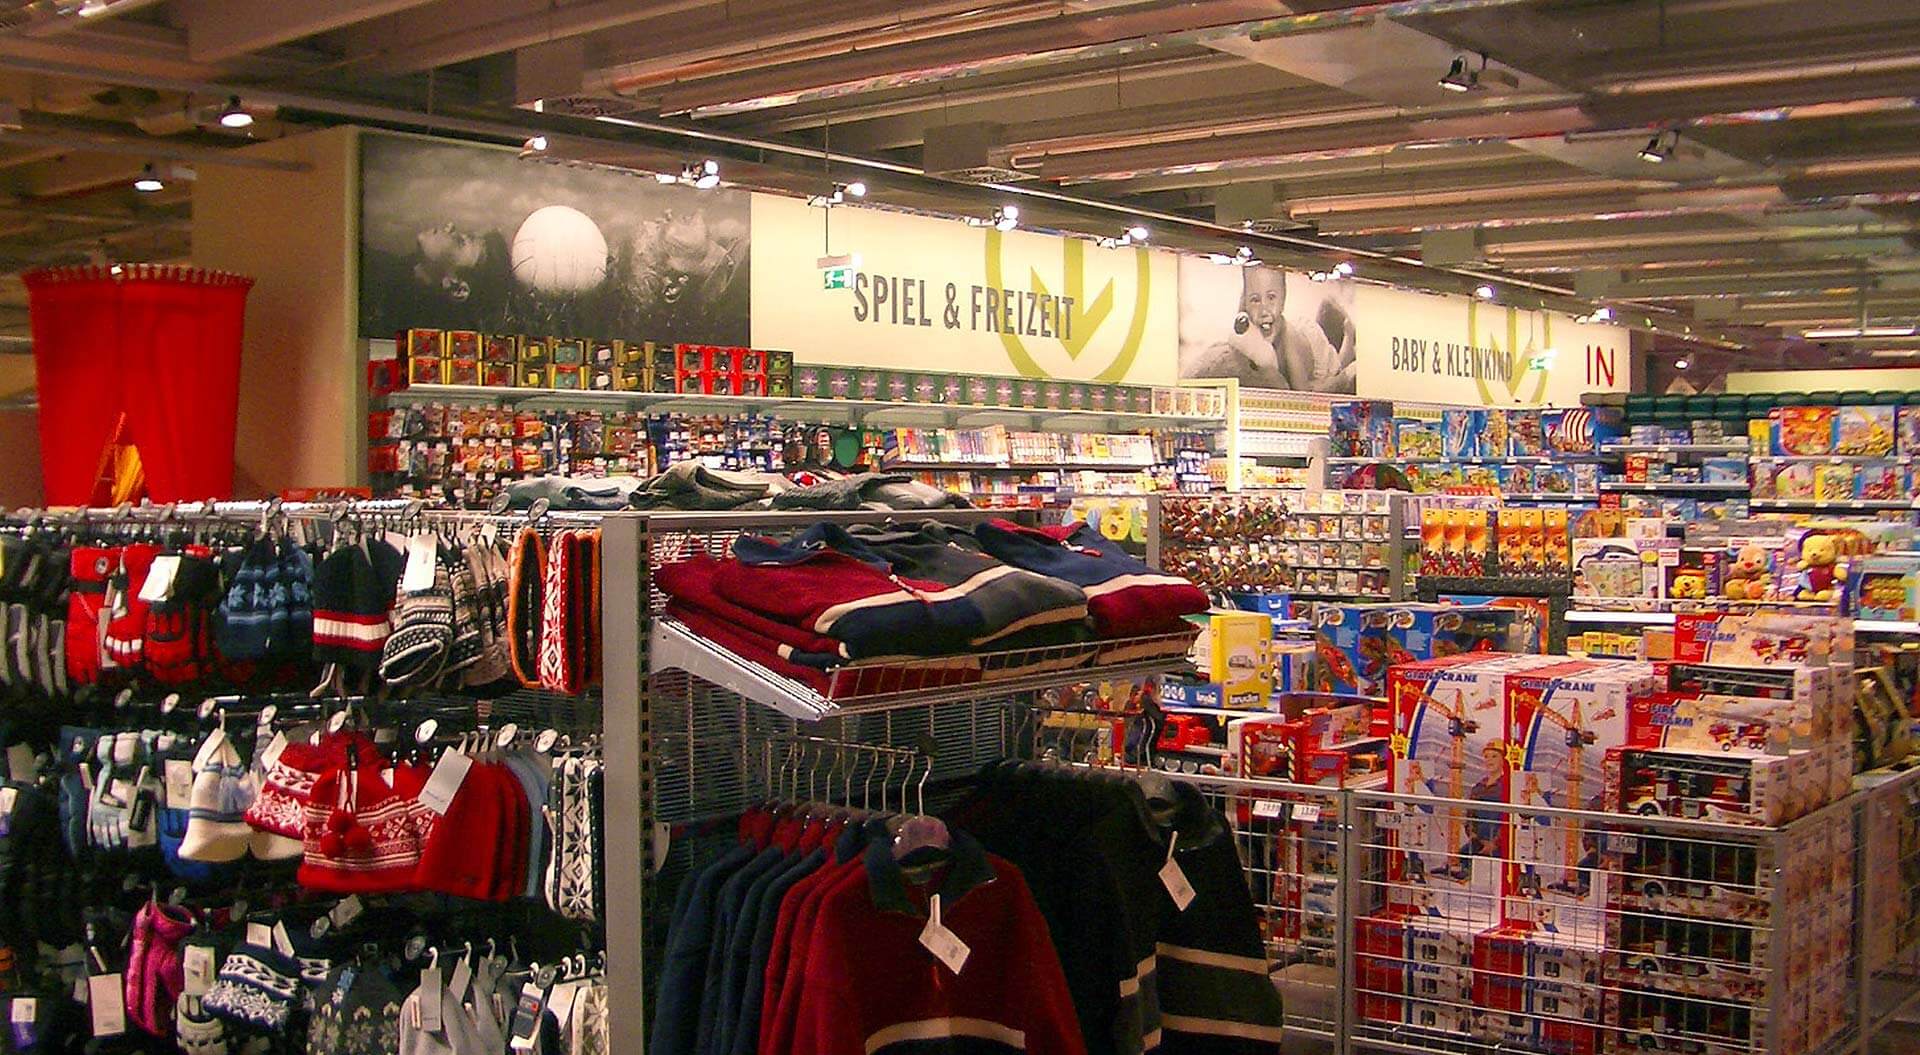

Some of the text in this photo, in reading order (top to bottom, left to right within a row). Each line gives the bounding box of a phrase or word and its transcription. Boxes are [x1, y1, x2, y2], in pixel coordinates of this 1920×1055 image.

[853, 272, 1075, 340] SPIEL & FREIZEIT
[1392, 336, 1513, 383] BABY & KLEINKIND
[1587, 344, 1614, 388] IN
[1441, 673, 1477, 683] CRANE
[1558, 681, 1595, 692] CRANE
